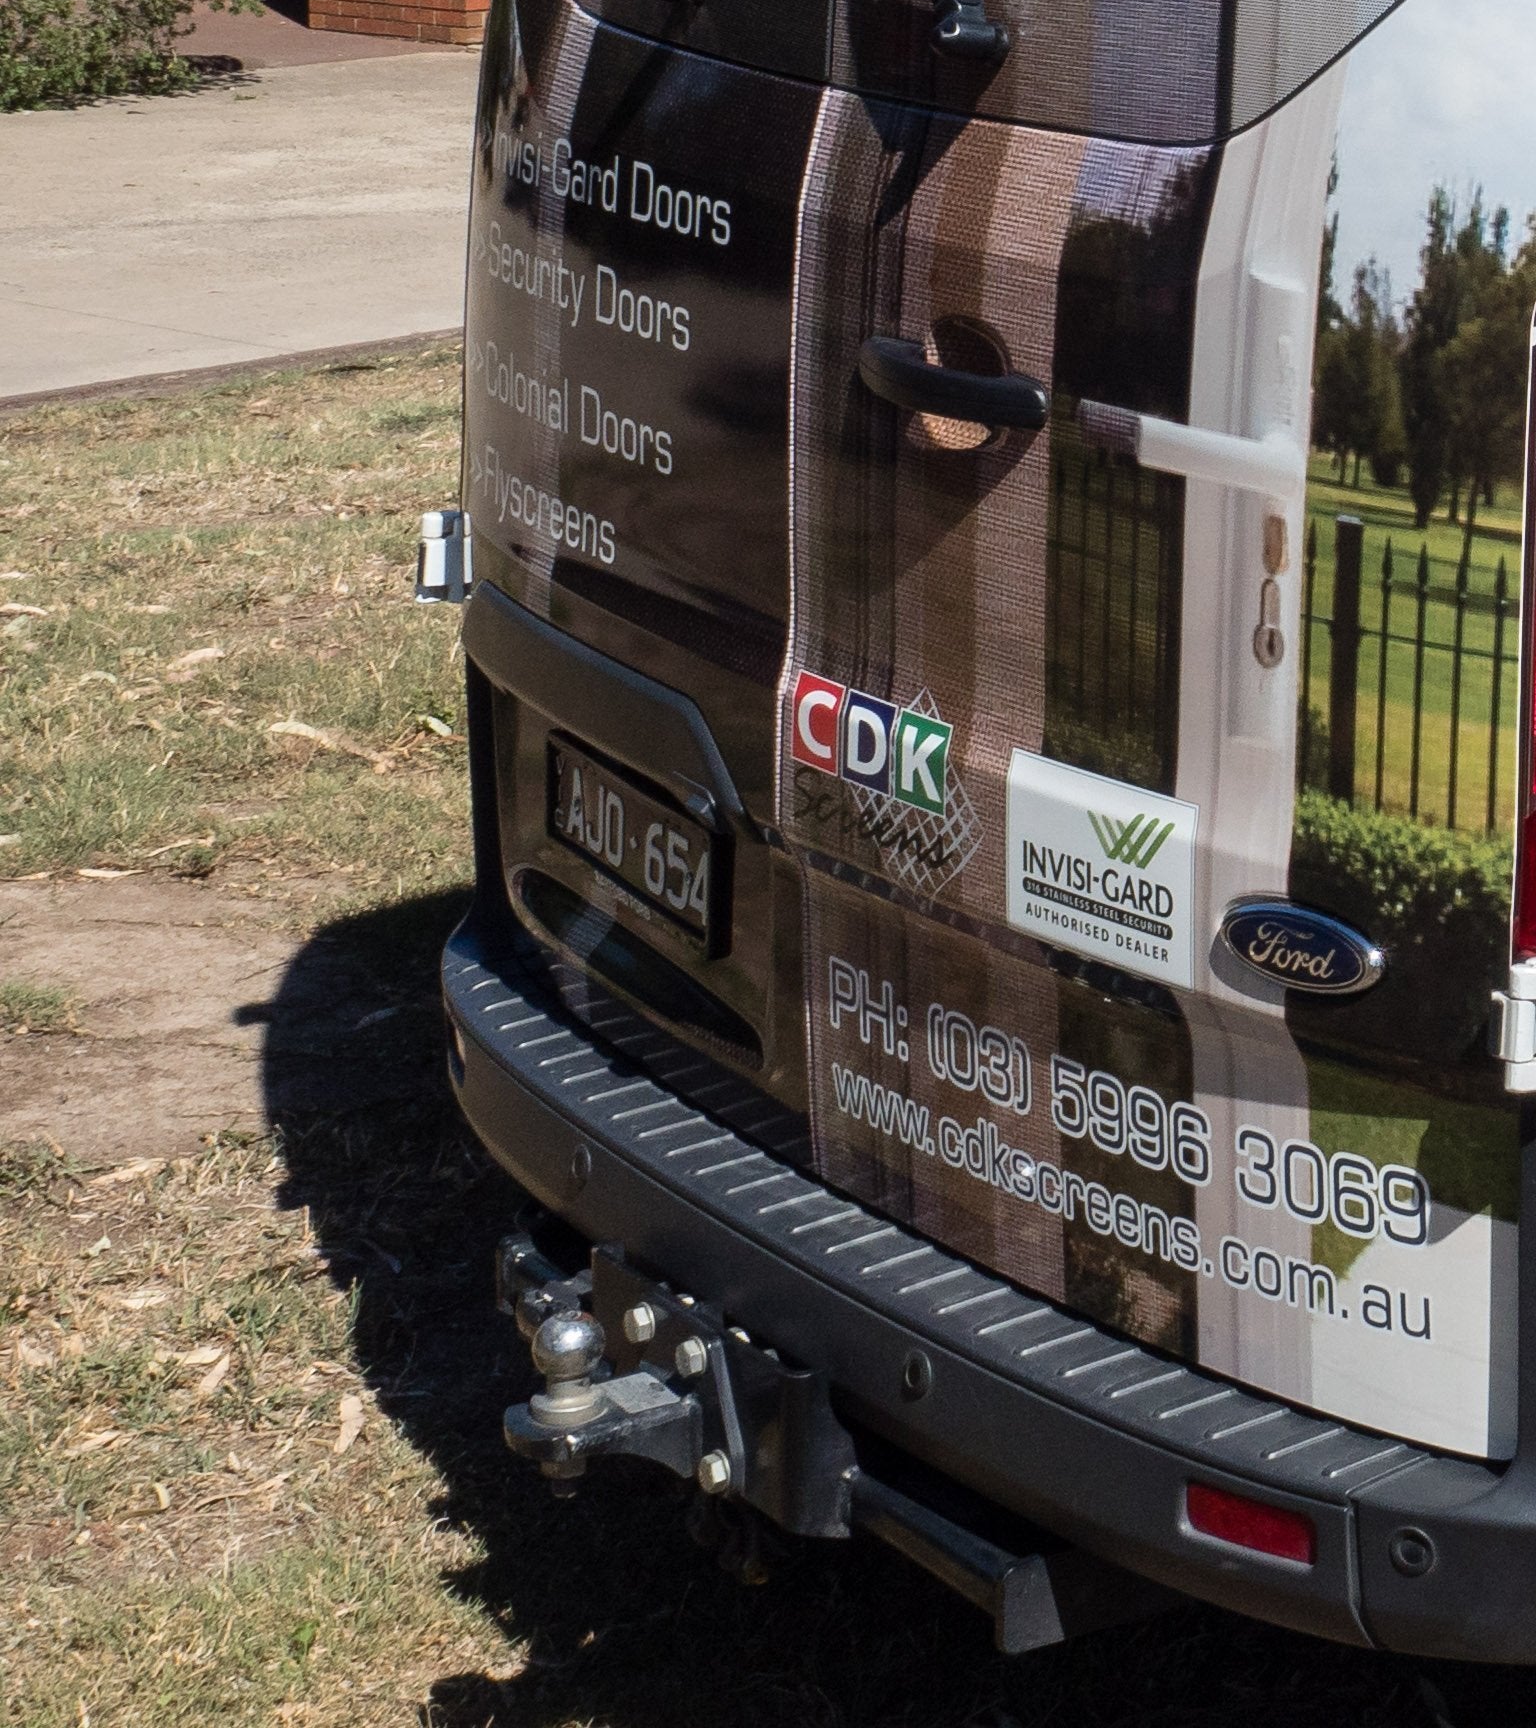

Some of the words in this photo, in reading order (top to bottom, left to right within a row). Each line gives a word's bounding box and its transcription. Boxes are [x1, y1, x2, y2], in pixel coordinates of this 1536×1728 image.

[630, 159, 731, 246] Doors
[488, 220, 585, 327] Security
[595, 263, 690, 351] Doors
[485, 339, 569, 434] Colonial
[580, 384, 673, 475] Doors
[483, 444, 616, 565] Flyscreens
[796, 688, 946, 804] CDK
[1022, 839, 1174, 918] INVISI-GARD
[1025, 901, 1110, 942] AUTHORISED
[1115, 932, 1169, 963] DEALER
[1043, 886, 1091, 911] STAINLESS
[1093, 903, 1120, 922] STEEL
[1122, 913, 1169, 937] SECURITY
[1248, 921, 1337, 979] Ford
[828, 955, 909, 1063] PH:
[927, 1002, 1032, 1115] (03)
[1050, 1054, 1213, 1187] 5996
[1234, 1123, 1431, 1247] 3069
[831, 1062, 1434, 1341] www.cdkscreens.com.au
